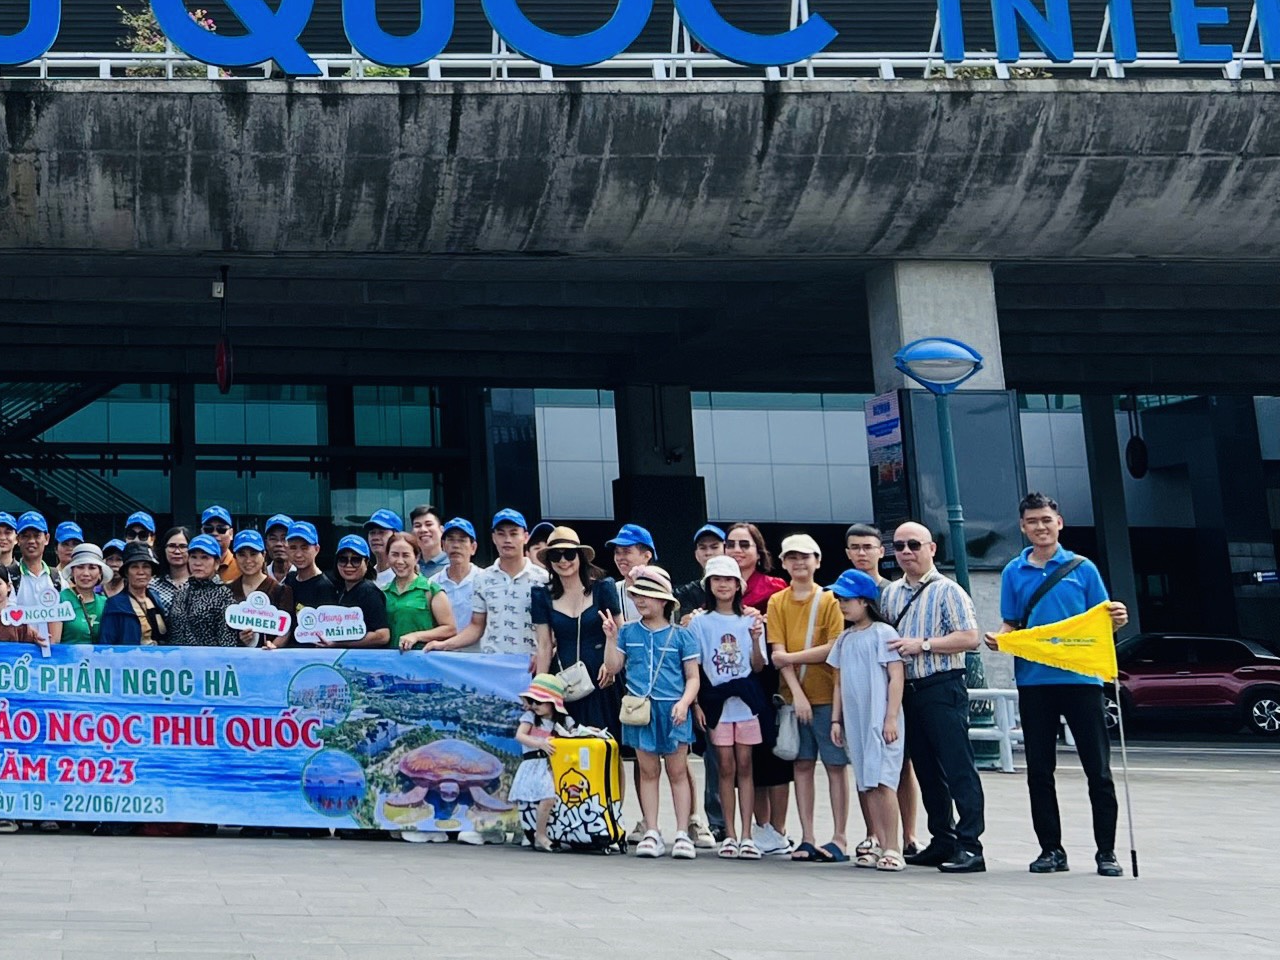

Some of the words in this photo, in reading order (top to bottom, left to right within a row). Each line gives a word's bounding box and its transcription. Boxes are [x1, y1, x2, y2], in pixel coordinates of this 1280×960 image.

[229, 614, 276, 630] NUMBER
[278, 615, 288, 632] 1
[40, 658, 111, 694] PHẦN
[122, 668, 193, 701] NGỌC
[205, 664, 239, 697] HÀ
[48, 711, 142, 750] NGỌC
[152, 709, 215, 746] PHÚ
[225, 708, 322, 750] QUỐC
[58, 758, 136, 784] 2023
[23, 793, 42, 811] 19
[64, 795, 164, 814] 22/06/2023
